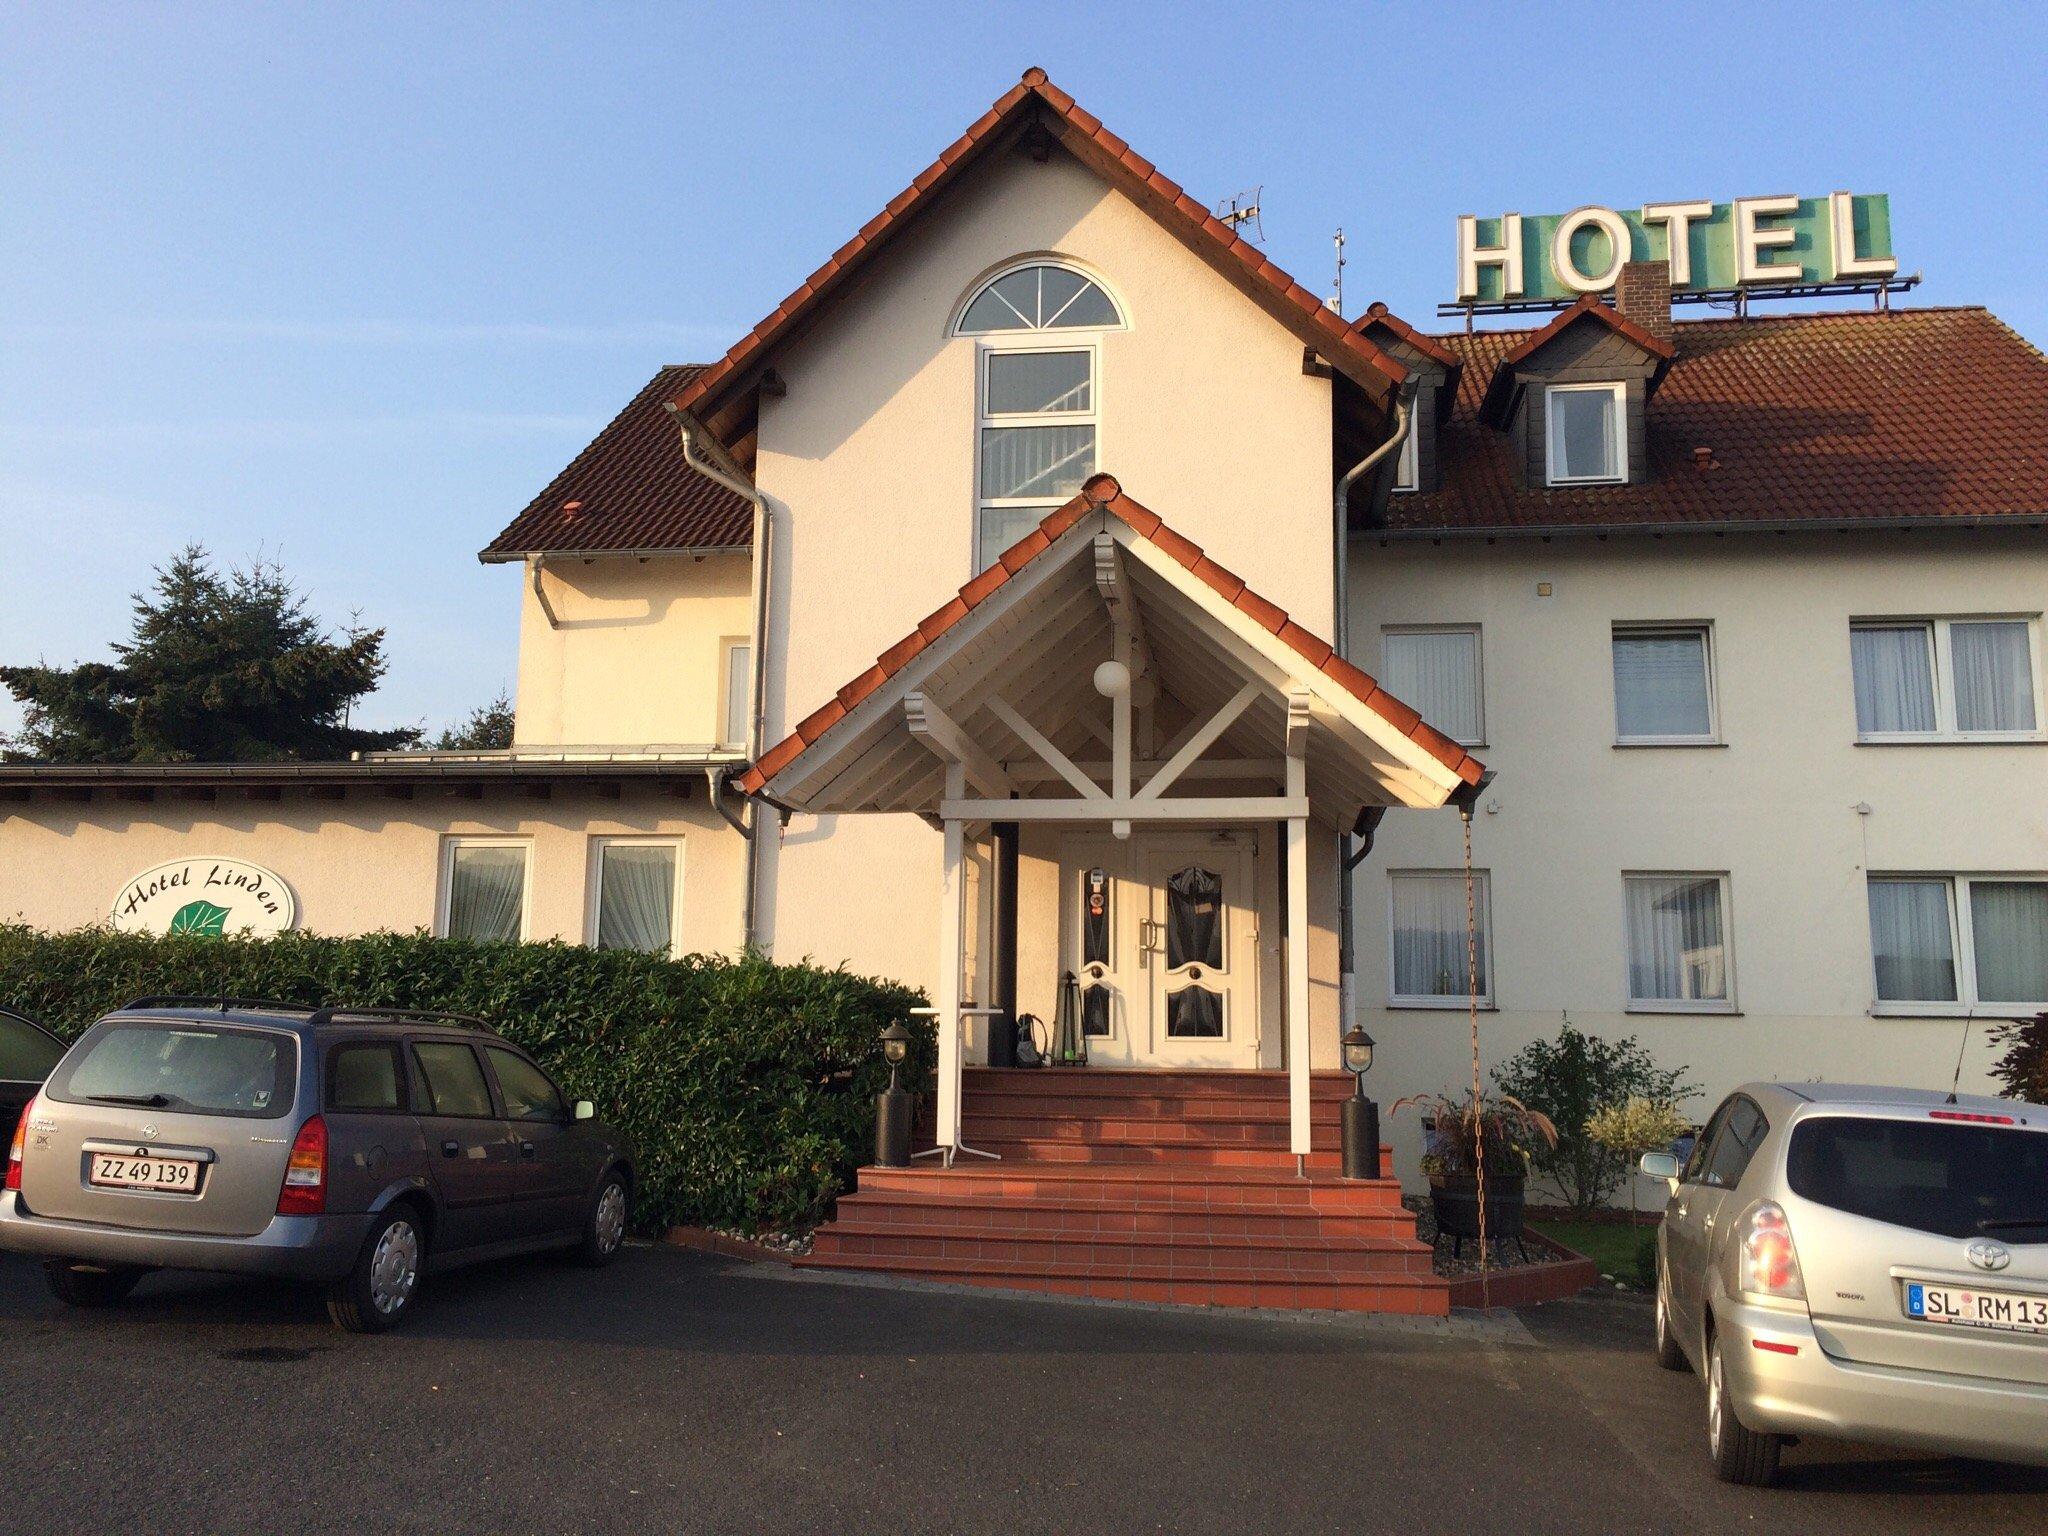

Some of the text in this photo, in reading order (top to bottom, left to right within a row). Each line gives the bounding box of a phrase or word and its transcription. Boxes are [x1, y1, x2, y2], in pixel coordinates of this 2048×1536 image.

[1456, 190, 1897, 301] HOTEL
[124, 864, 279, 915] Hotel Linden
[100, 1160, 189, 1184] ZZ 49 139
[1928, 1291, 2048, 1325] SL RM 13
